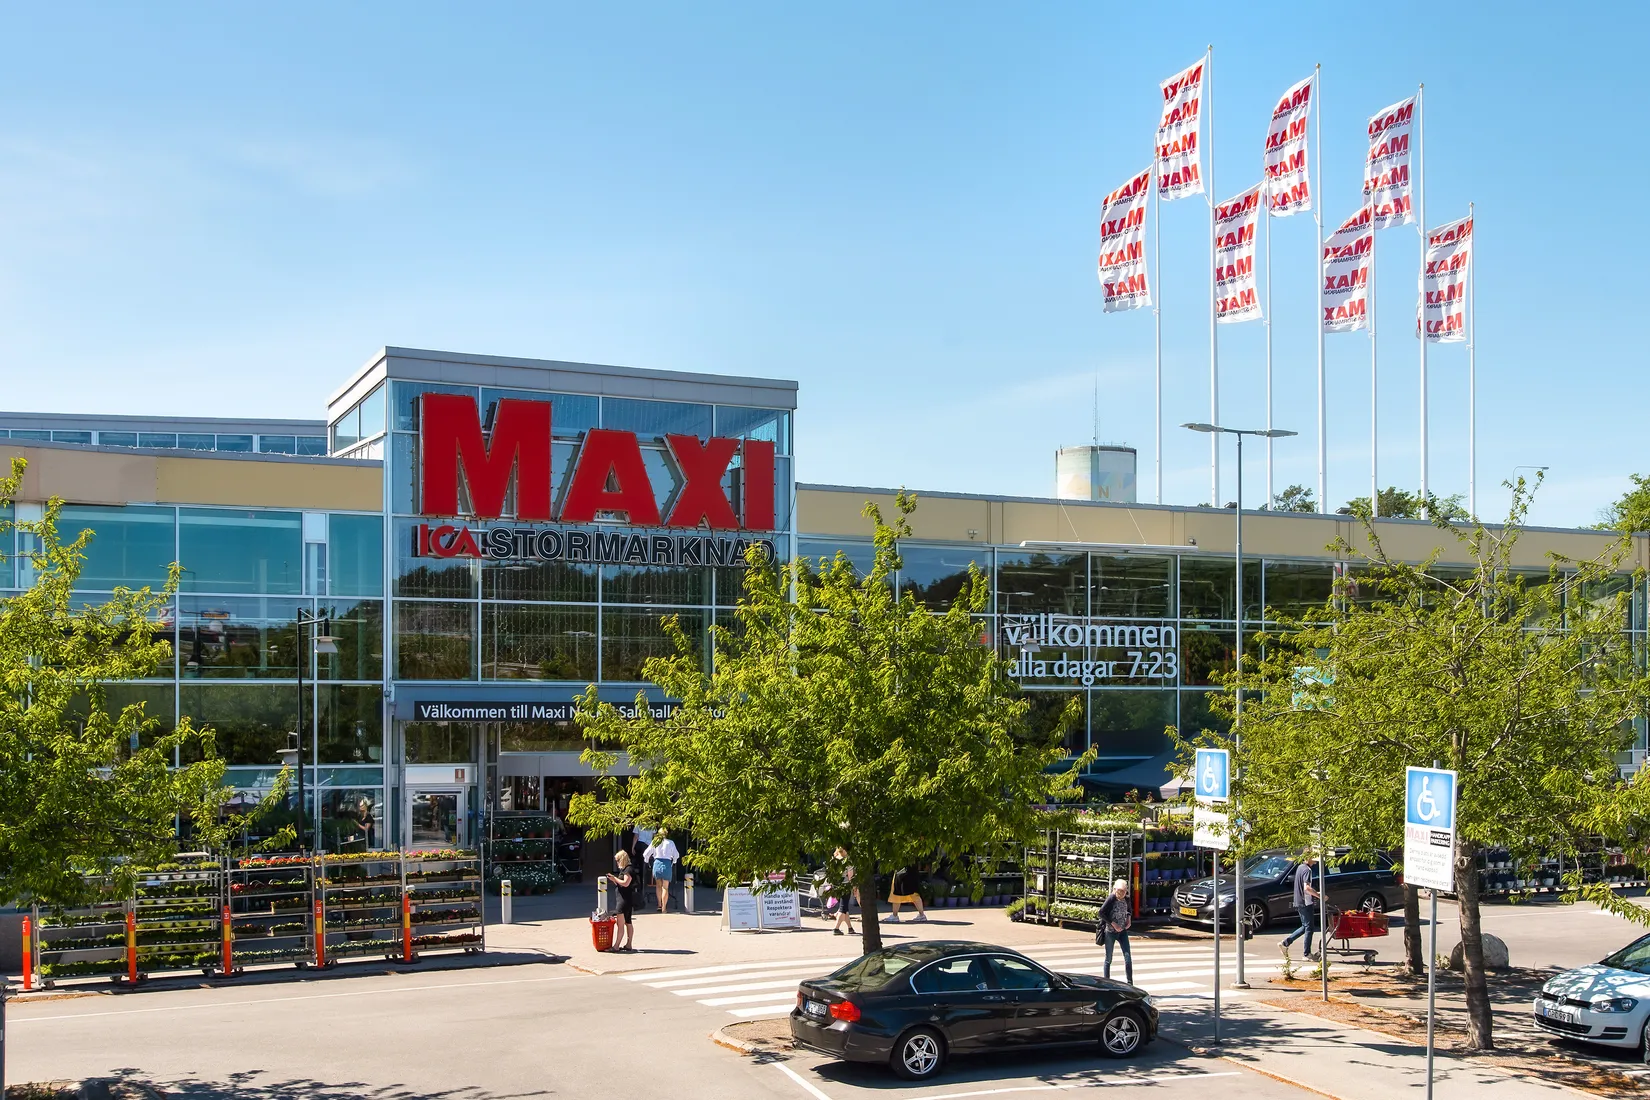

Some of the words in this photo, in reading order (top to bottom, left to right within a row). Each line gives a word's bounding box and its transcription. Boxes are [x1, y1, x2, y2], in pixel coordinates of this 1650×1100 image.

[419, 392, 775, 531] MAXI
[418, 523, 483, 559] ICA
[487, 527, 777, 567] STORMARKNAD
[1053, 652, 1117, 685] dagar
[1127, 651, 1177, 679] 7-23
[421, 704, 507, 719] Välkommen
[510, 704, 528, 719] till
[532, 705, 566, 719] Maxi
[1406, 827, 1428, 841] MAXI
